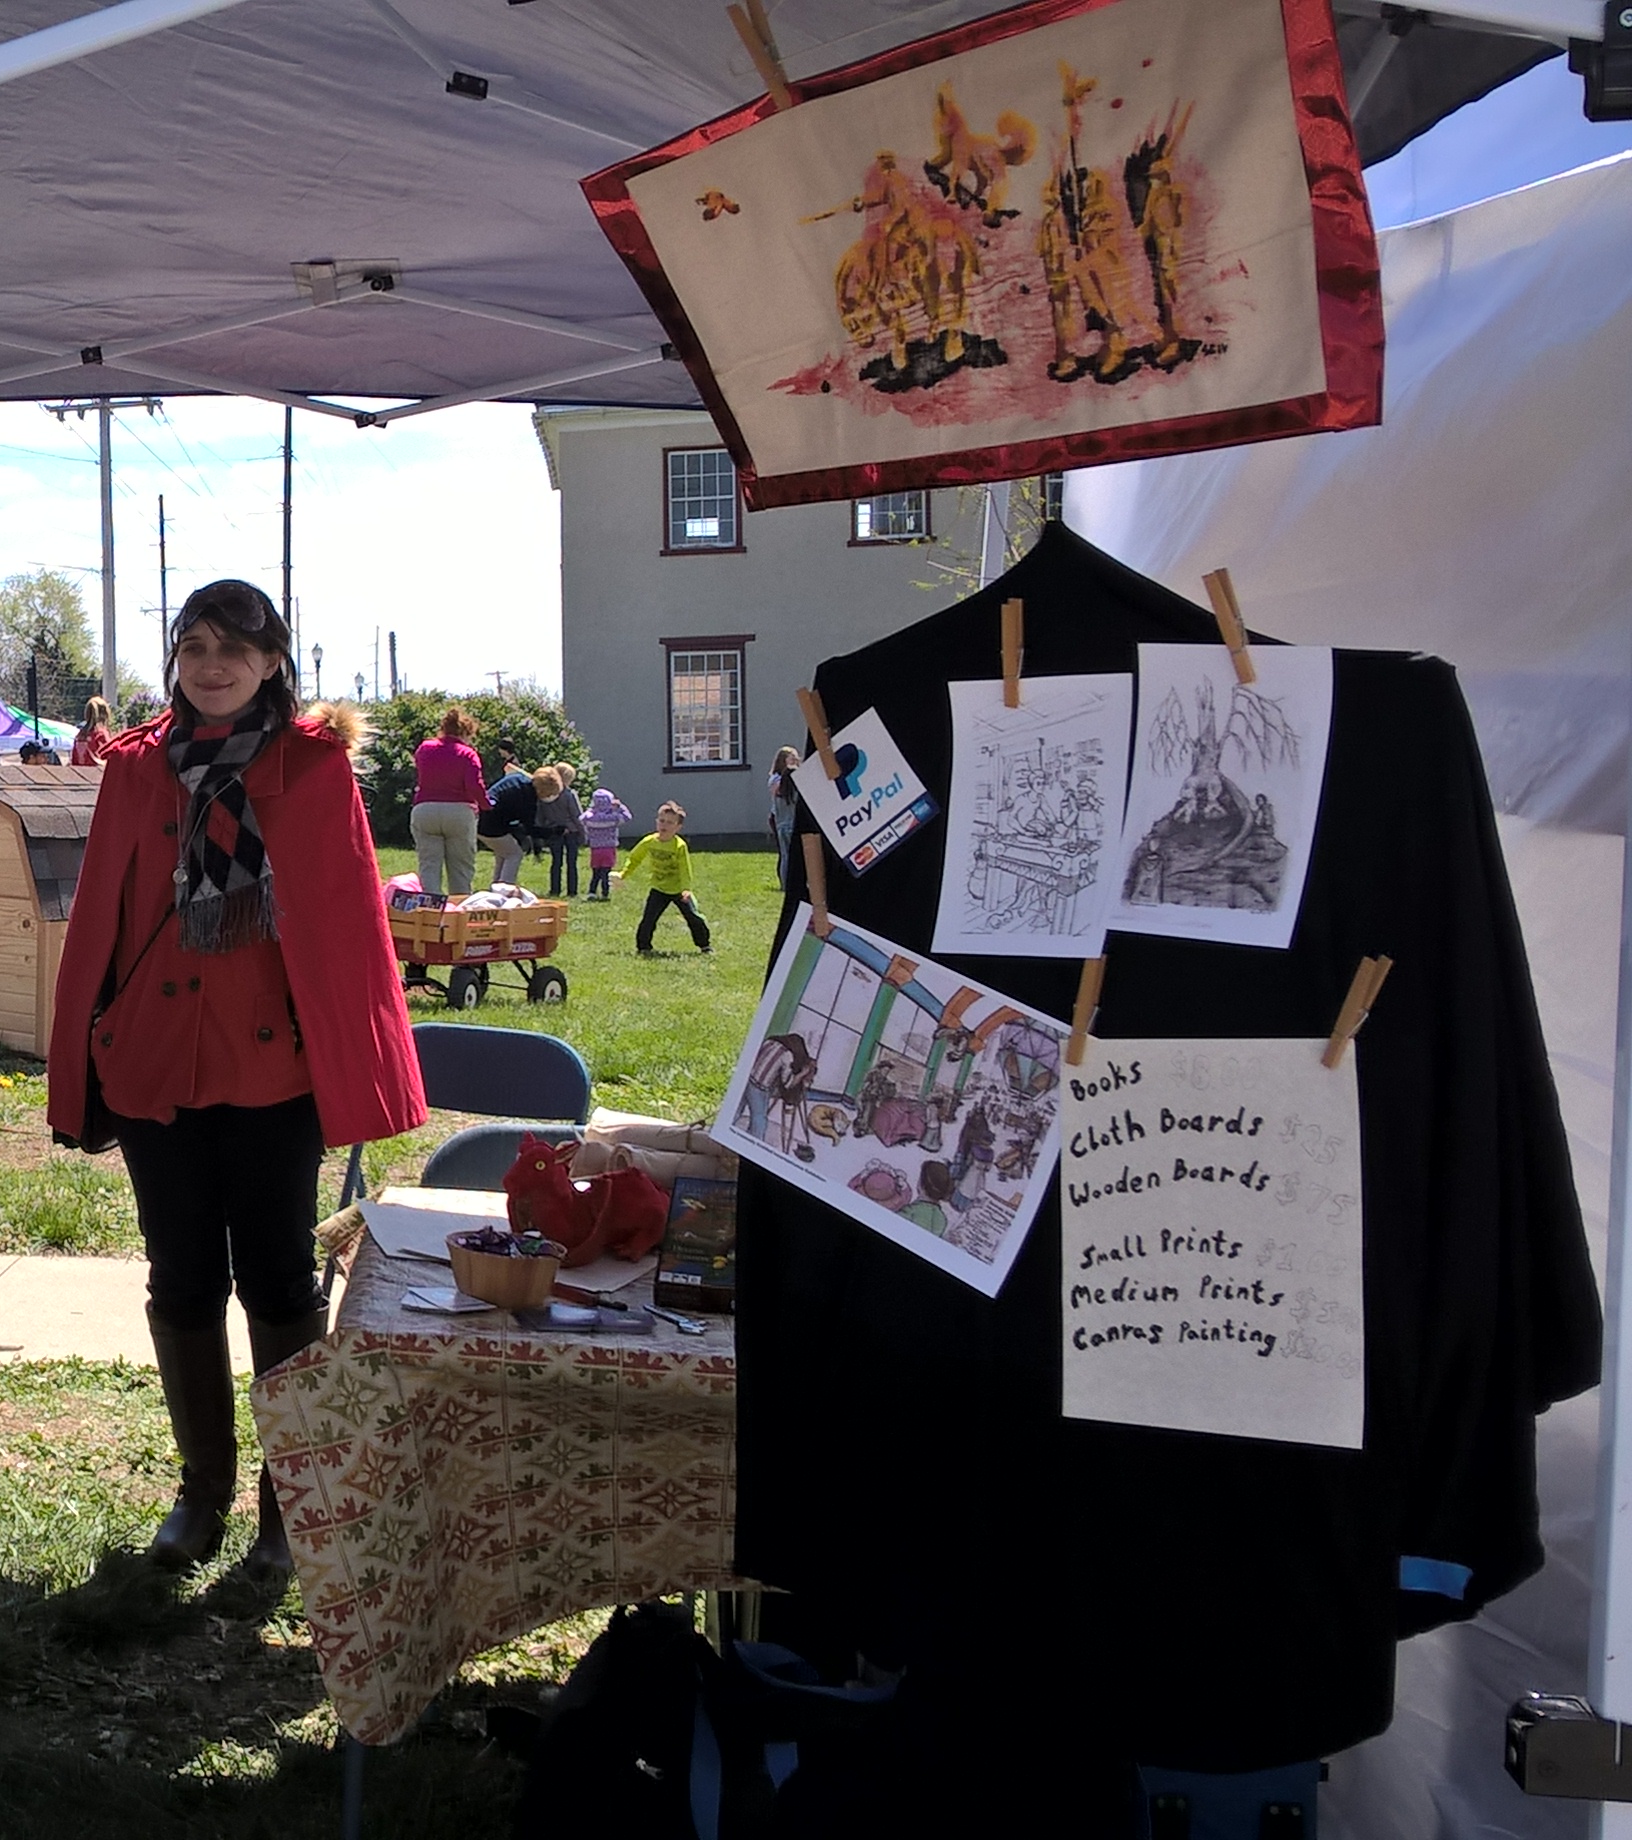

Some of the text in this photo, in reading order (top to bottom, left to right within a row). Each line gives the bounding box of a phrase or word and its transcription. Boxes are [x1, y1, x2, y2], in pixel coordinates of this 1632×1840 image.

[835, 772, 904, 837] PayPal
[875, 831, 894, 848] VISA
[468, 911, 498, 921] ATW
[1070, 1060, 1142, 1101] Books
[1070, 1109, 1146, 1158] Cloth
[1159, 1106, 1264, 1137] Boards
[1069, 1165, 1161, 1207] Wooden
[1172, 1158, 1271, 1192] Boards
[1080, 1234, 1147, 1270] Small
[1160, 1226, 1243, 1259] Prints
[1070, 1276, 1180, 1309] Medium
[1199, 1274, 1286, 1307] Prints
[1072, 1322, 1164, 1351] Canvas
[1179, 1319, 1278, 1357] Painting
